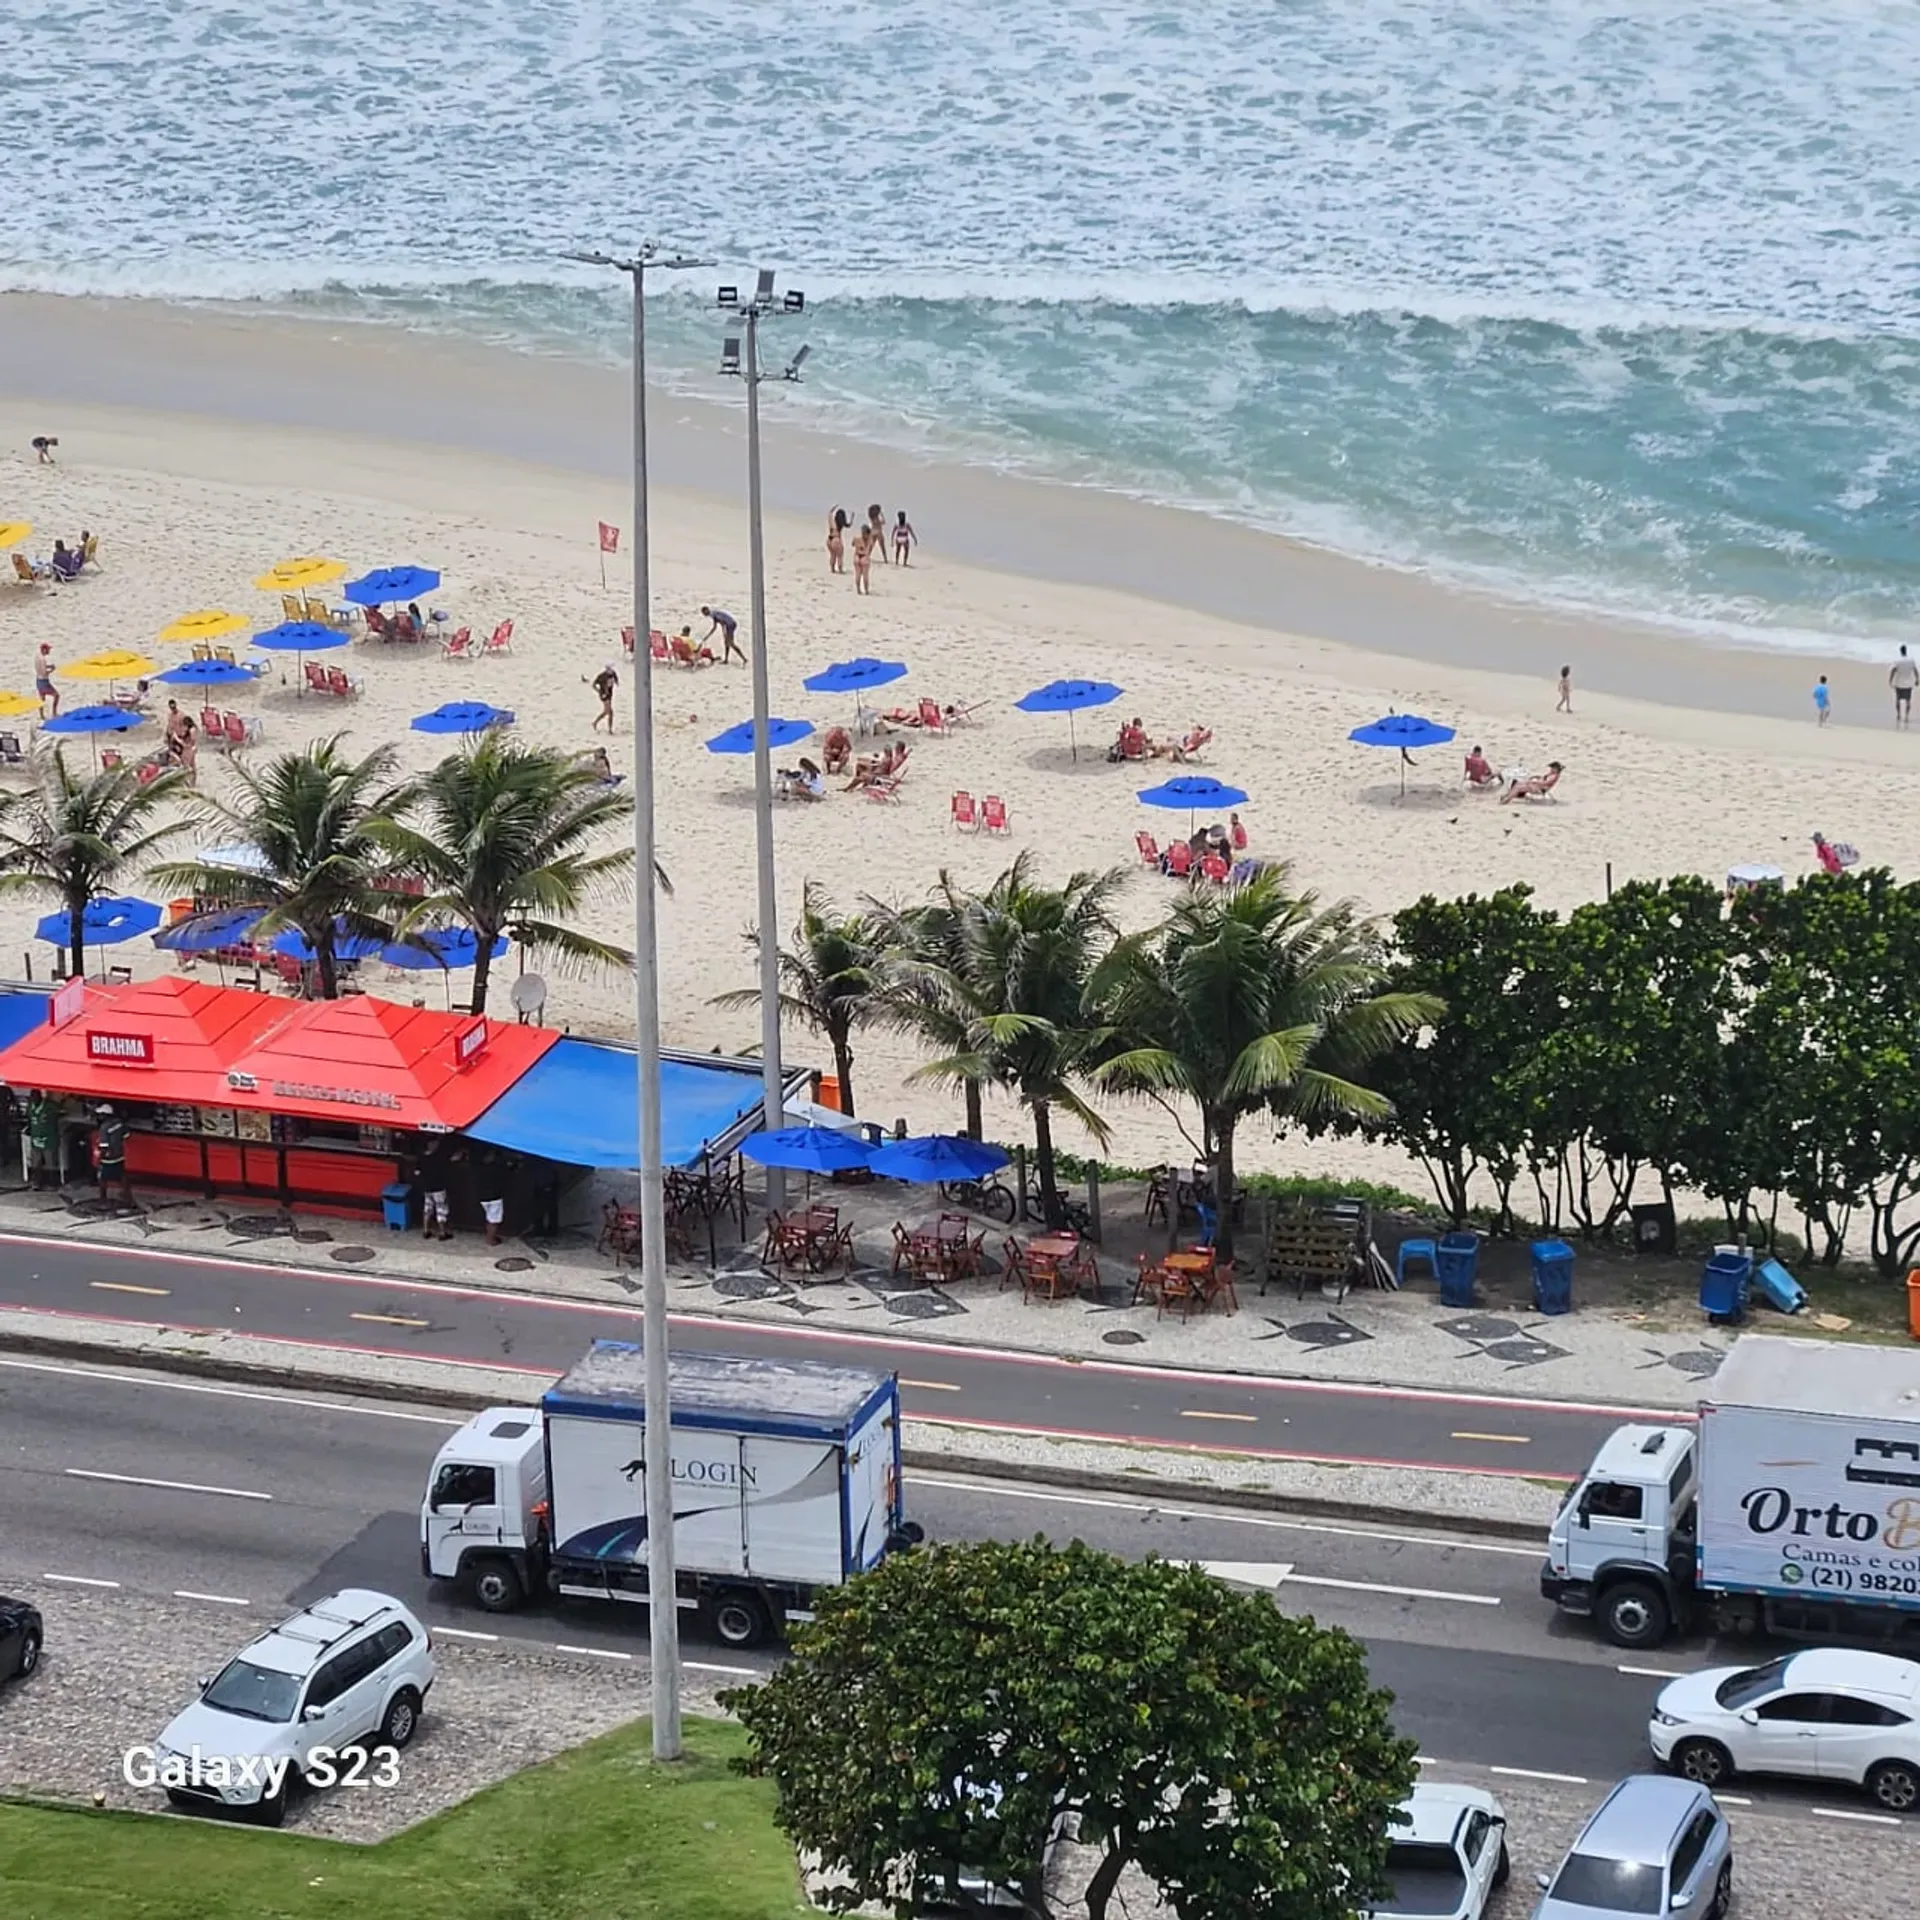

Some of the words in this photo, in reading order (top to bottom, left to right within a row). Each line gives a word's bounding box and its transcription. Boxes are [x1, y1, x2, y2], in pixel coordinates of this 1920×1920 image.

[91, 1036, 146, 1057] BRAHMA
[671, 1459, 757, 1485] LOGIN
[1782, 1543, 1861, 1567] Camas
[1869, 1557, 1881, 1569] e
[1811, 1566, 1852, 1591] (21)
[1860, 1572, 1920, 1593] 9820
